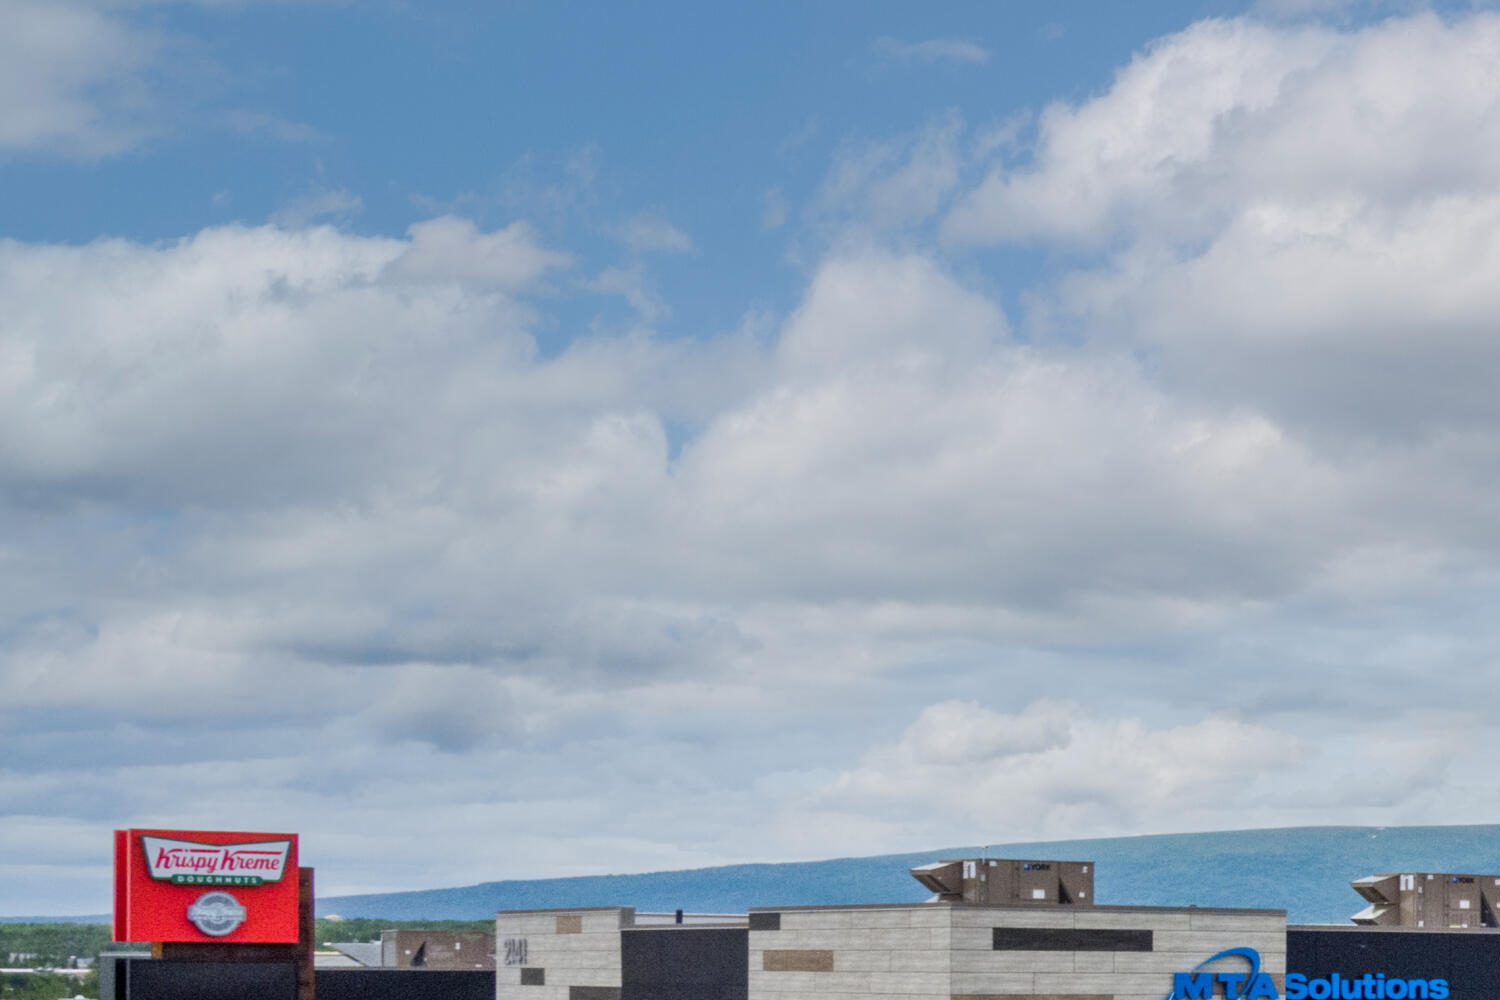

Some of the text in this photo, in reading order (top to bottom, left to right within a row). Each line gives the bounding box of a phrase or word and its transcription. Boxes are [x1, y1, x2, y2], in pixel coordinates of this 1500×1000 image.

[155, 847, 283, 873] Krispy Kreme
[177, 875, 258, 884] DOUGHNUTS
[1173, 972, 1449, 1000] MTA Solutions
